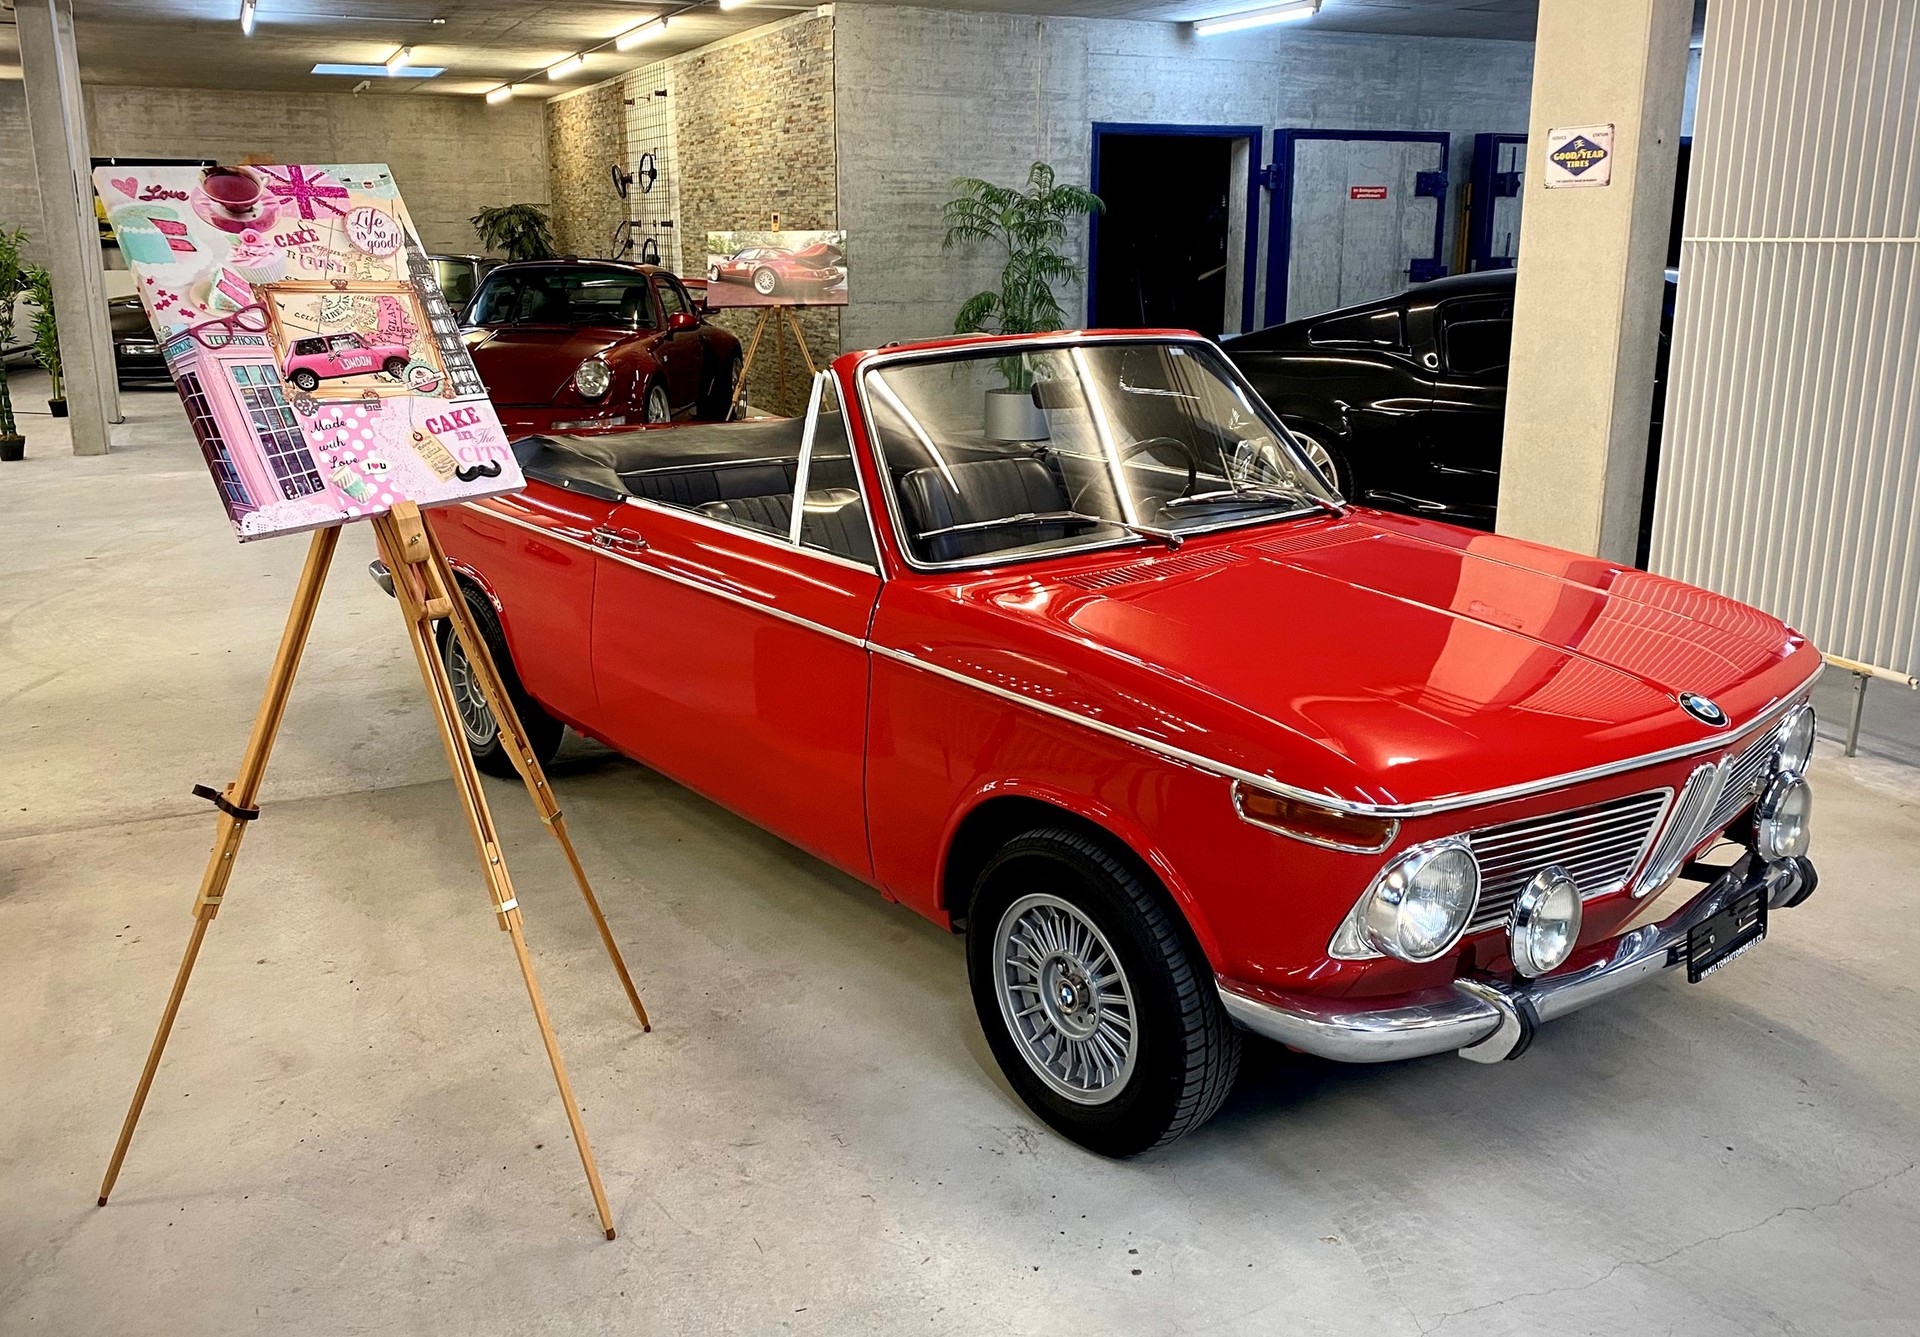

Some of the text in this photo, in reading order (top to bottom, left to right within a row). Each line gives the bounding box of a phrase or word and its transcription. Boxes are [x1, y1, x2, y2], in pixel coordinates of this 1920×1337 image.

[1567, 160, 1589, 168] TIRES
[139, 184, 189, 201] Love
[351, 208, 384, 235] Life
[274, 228, 320, 248] CAKE
[356, 227, 386, 240] is so
[298, 245, 314, 253] in
[367, 232, 398, 254] good!
[340, 356, 372, 370] LONDON
[310, 416, 347, 433] Made
[425, 406, 481, 435] CAKE
[319, 435, 347, 452] with
[455, 428, 496, 444] in The
[329, 455, 360, 469] Love
[458, 445, 511, 463] CITY
[1700, 933, 1764, 980] HAMILTONAUTOMOBILE.CH
